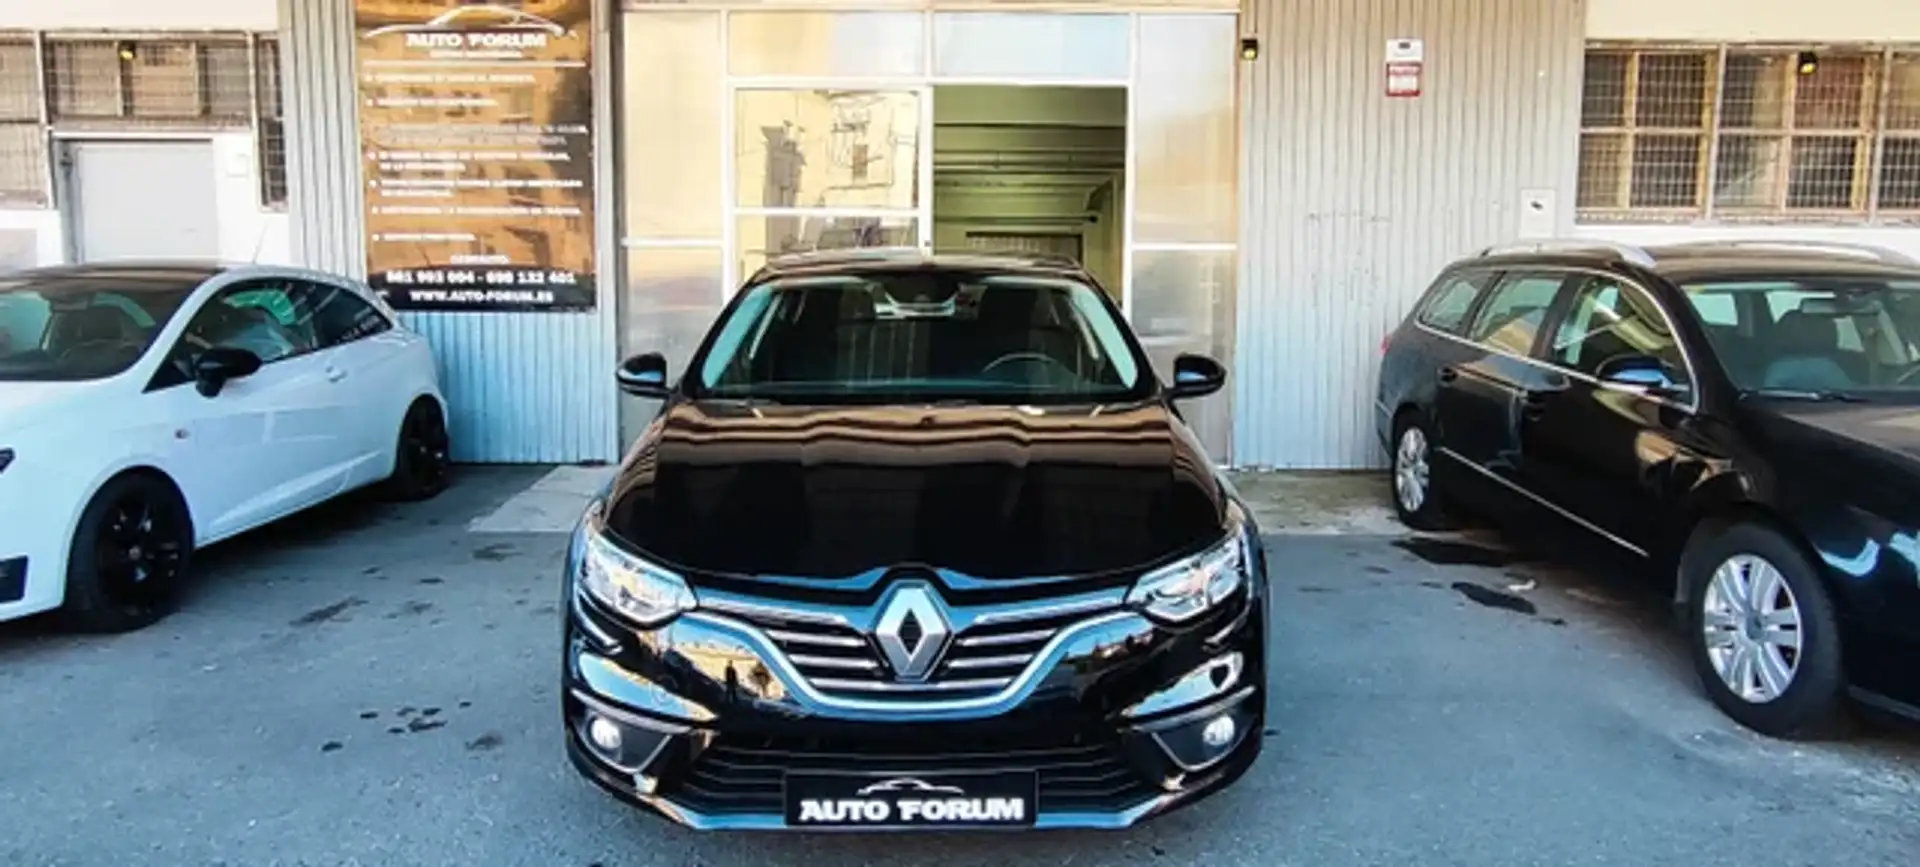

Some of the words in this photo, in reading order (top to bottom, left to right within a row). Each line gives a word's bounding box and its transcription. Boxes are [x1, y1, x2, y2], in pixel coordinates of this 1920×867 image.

[406, 33, 462, 47] AUTO
[468, 33, 546, 47] FORUM
[799, 800, 889, 821] AUTO
[897, 798, 1024, 821] FORUM
